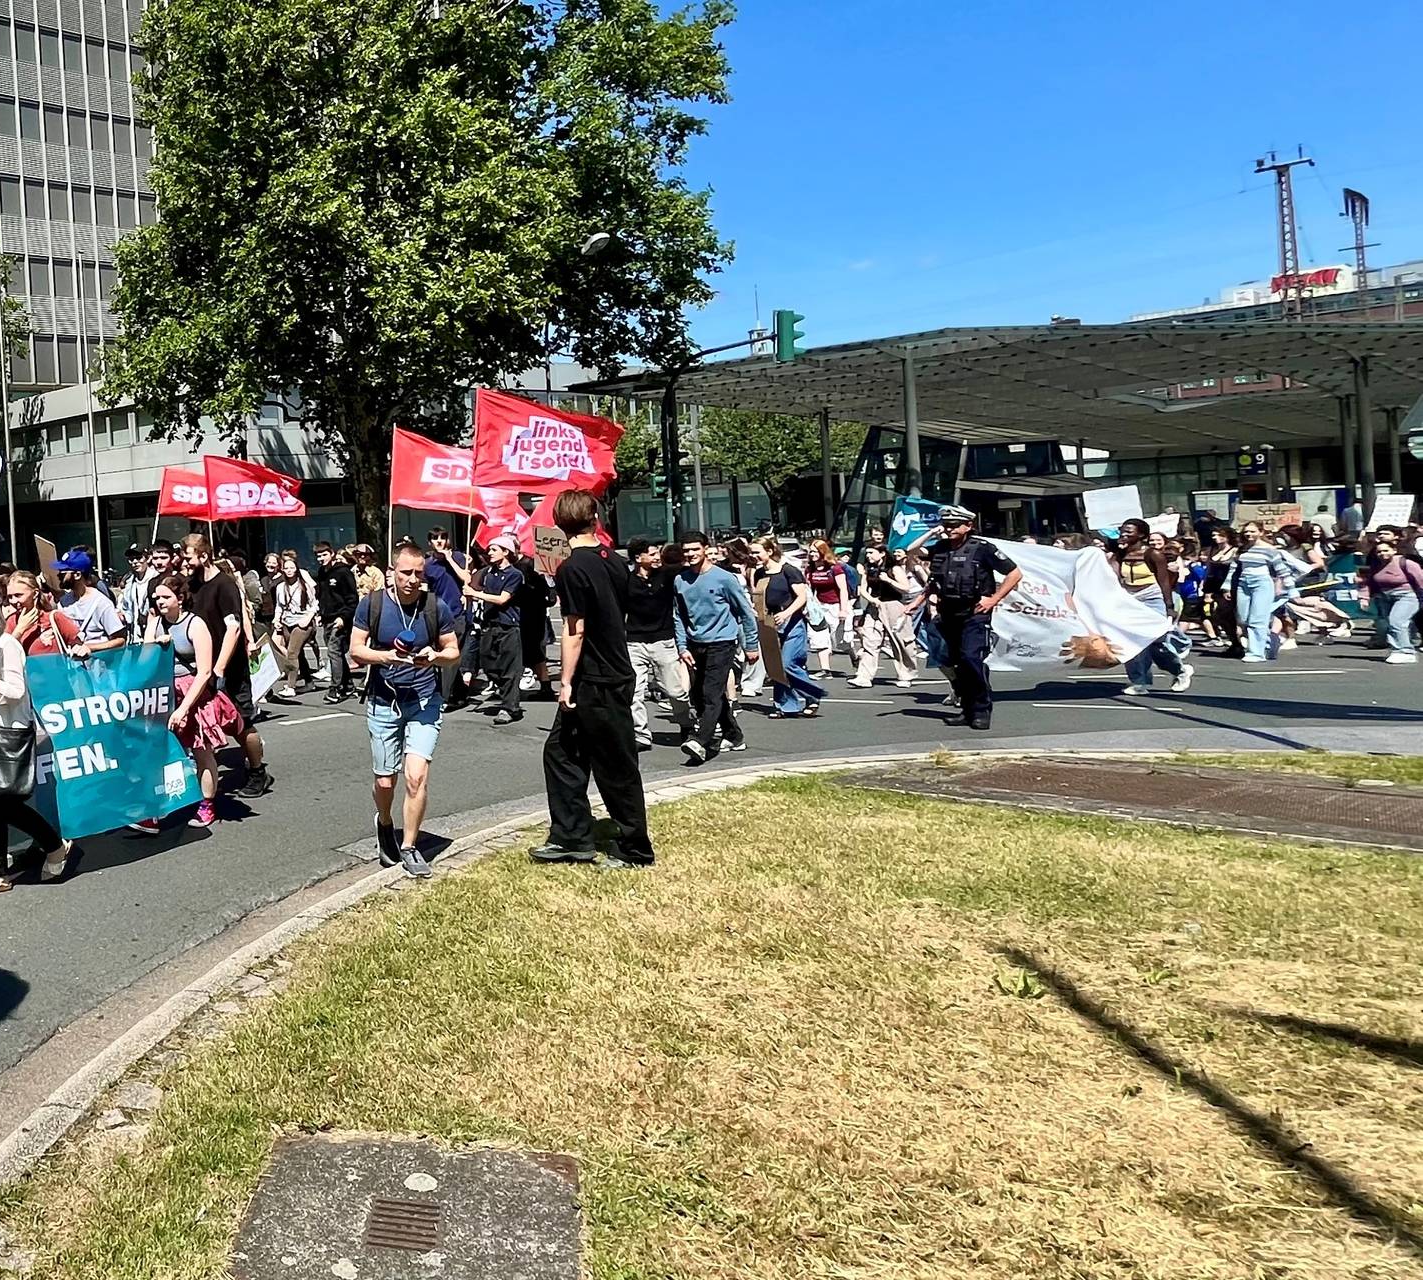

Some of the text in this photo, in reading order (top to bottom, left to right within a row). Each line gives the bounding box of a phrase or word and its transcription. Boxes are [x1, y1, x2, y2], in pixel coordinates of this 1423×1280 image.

[532, 420, 576, 439] links
[511, 435, 582, 456] jugend
[1255, 453, 1265, 465] 9
[431, 463, 473, 481] SD
[34, 686, 171, 735] STROPHE
